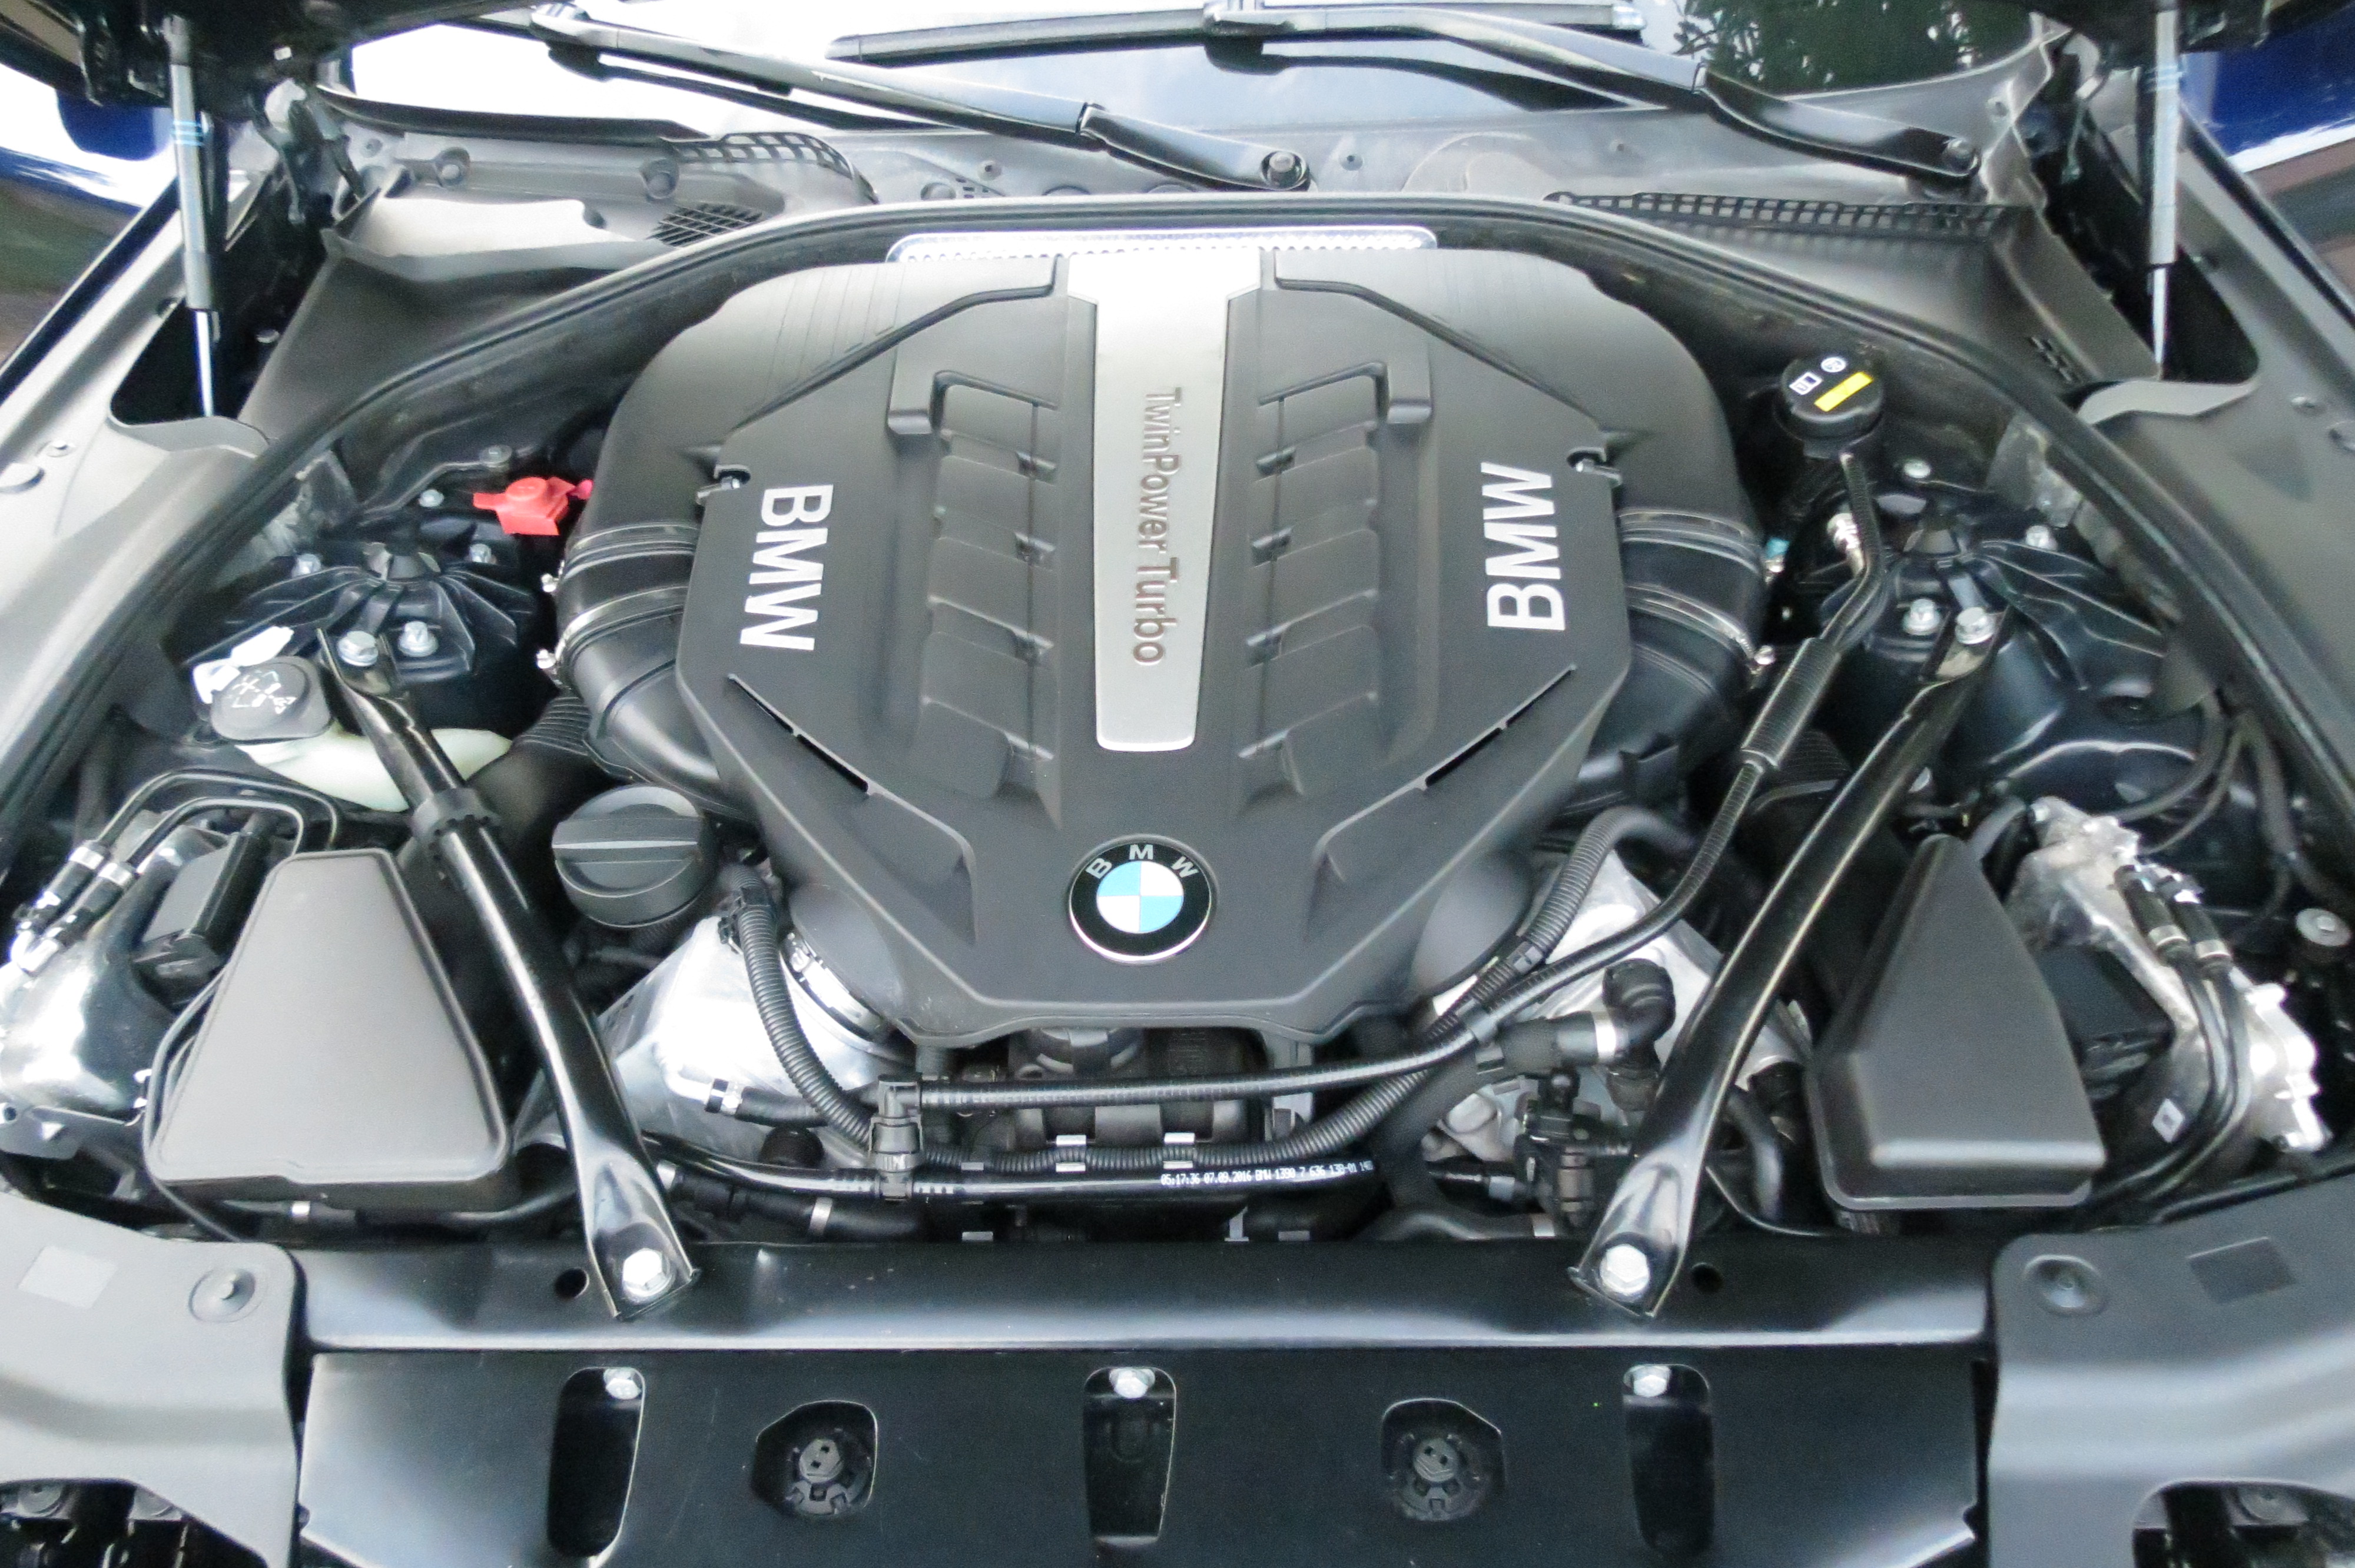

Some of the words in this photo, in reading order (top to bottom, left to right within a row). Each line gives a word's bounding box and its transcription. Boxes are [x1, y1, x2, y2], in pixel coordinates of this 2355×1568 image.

[1137, 387, 1182, 554] TwinPower
[740, 484, 834, 651] BMW
[1133, 557, 1179, 666] Turbo
[1480, 461, 1565, 631] BMW
[1086, 844, 1199, 879] BMW
[1160, 1173, 1200, 1185] 05:17:36
[1255, 1169, 1272, 1181] BMW
[1275, 1167, 1296, 1180] 1390
[1299, 1167, 1306, 1177] 7
[1309, 1165, 1326, 1177] 636
